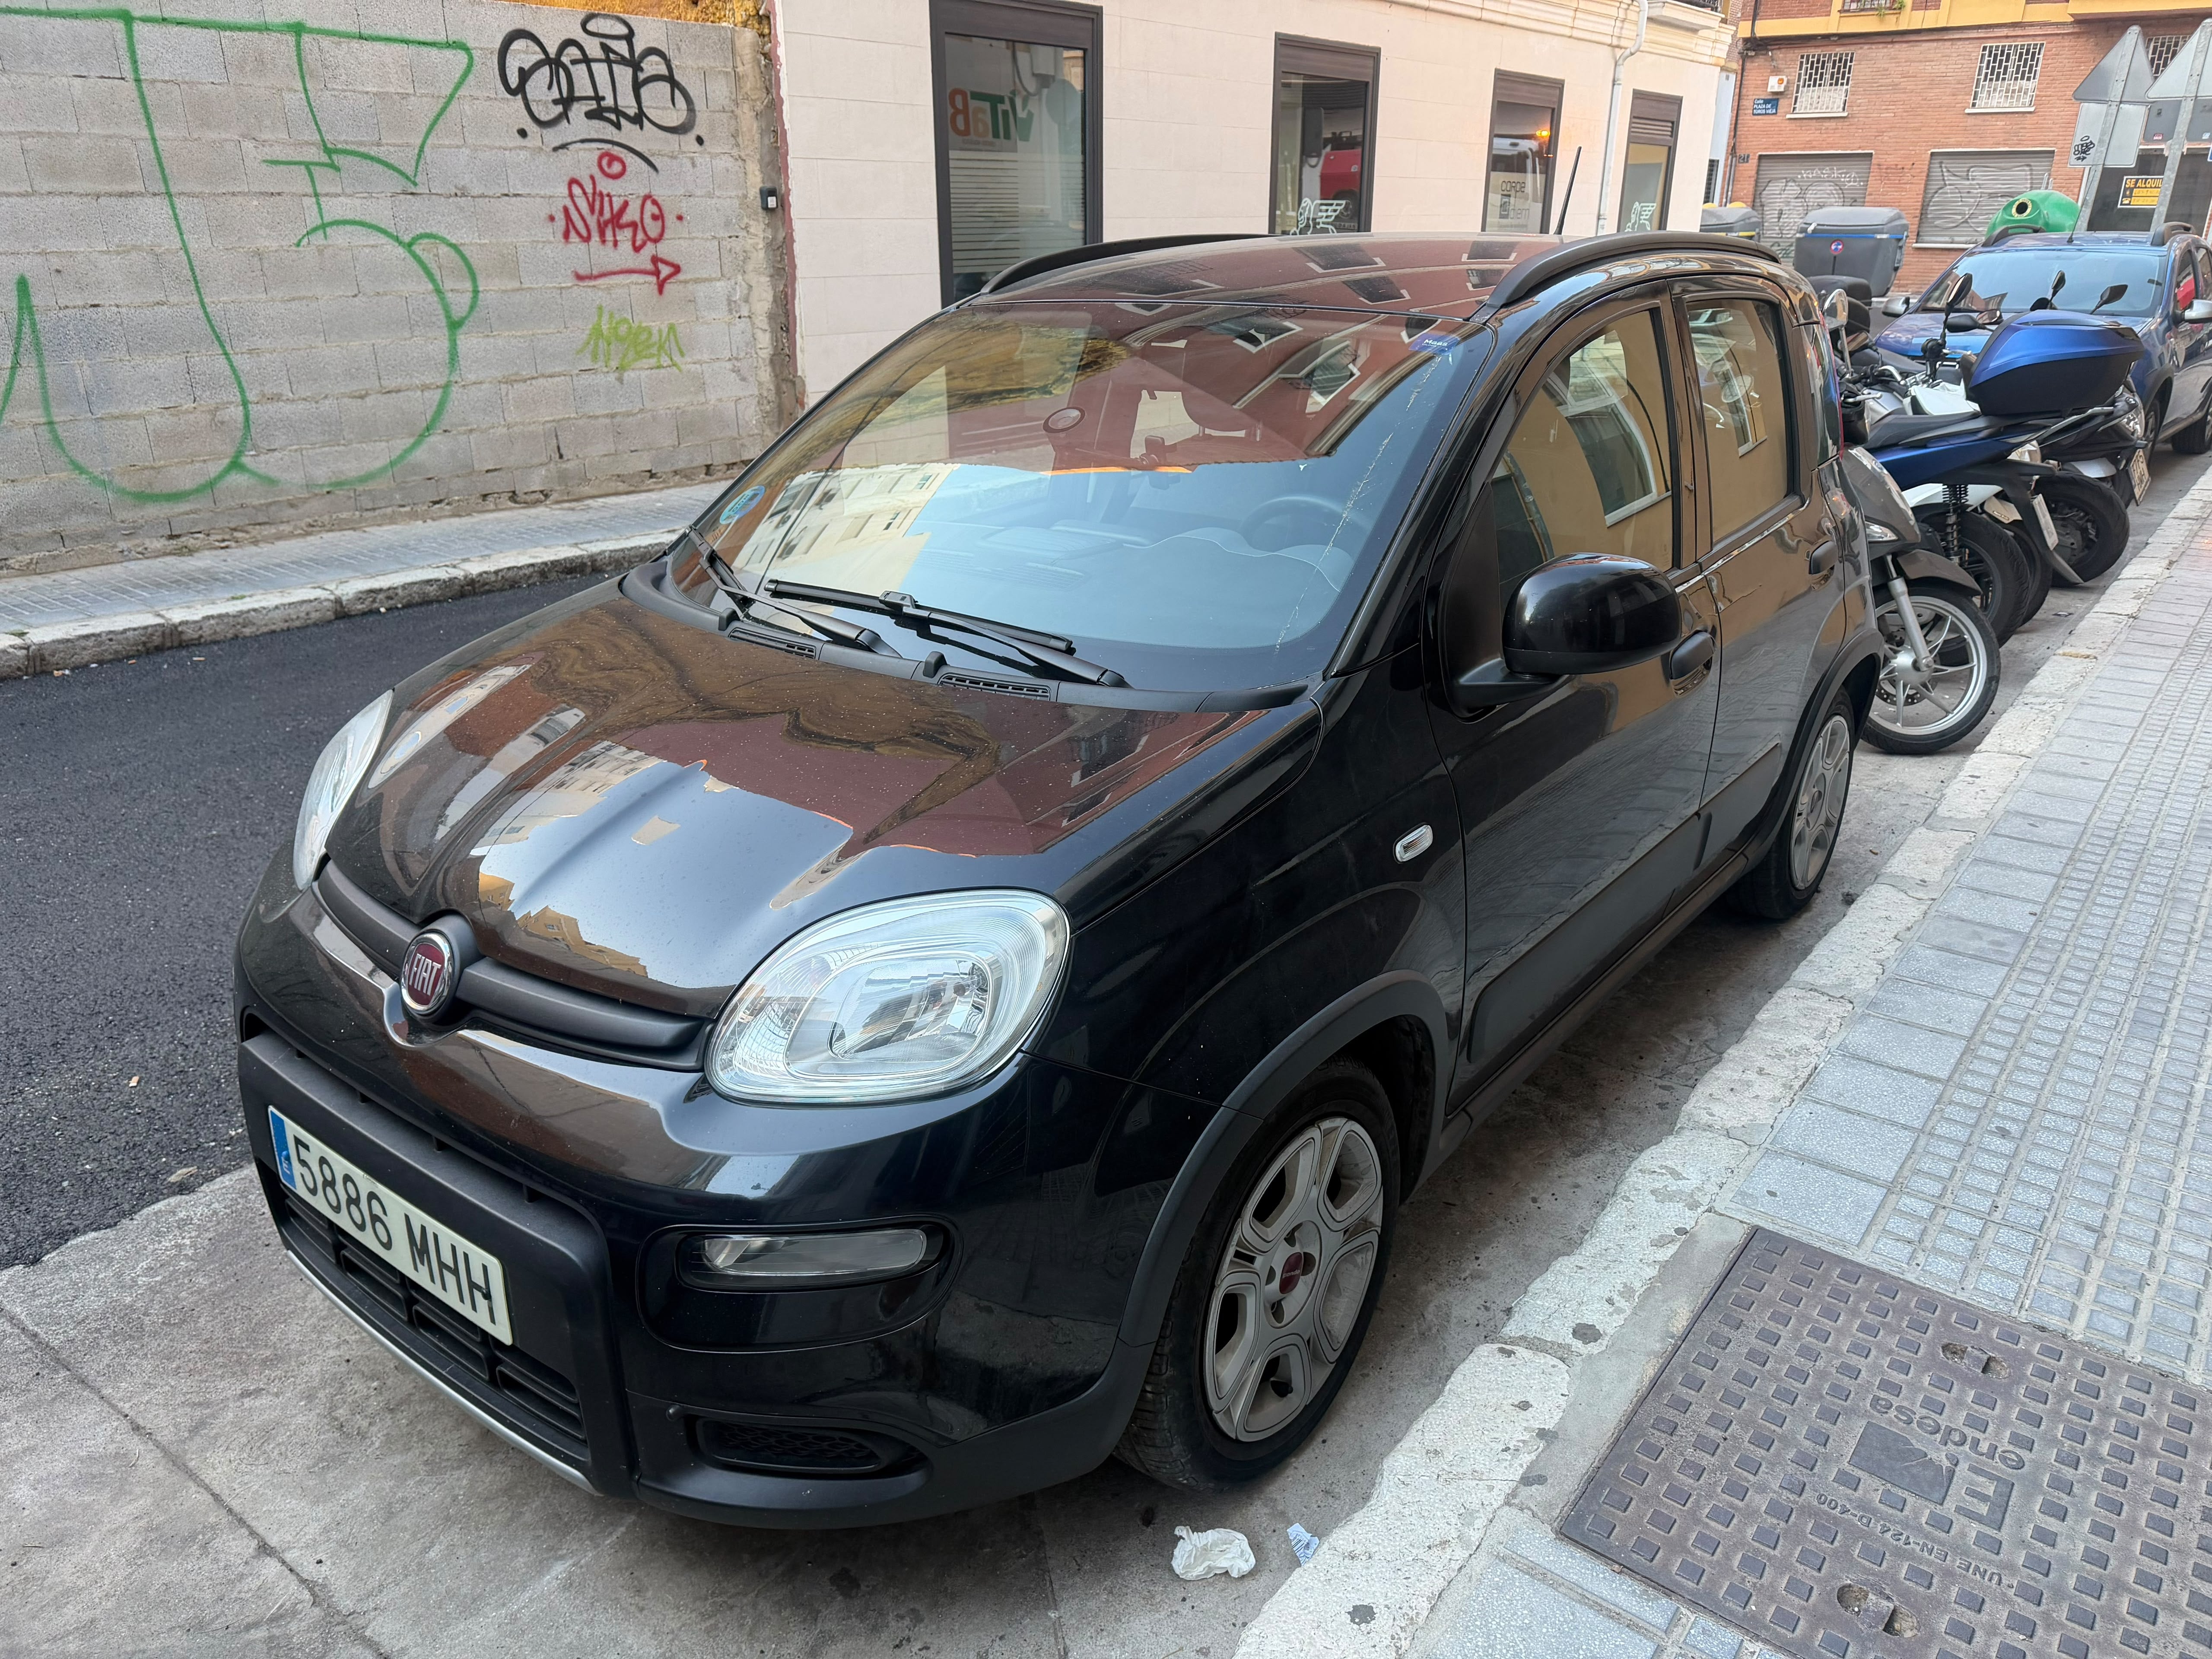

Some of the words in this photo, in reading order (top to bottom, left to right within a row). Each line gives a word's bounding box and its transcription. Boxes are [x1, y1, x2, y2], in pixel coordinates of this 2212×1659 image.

[1739, 154, 1747, 162] 21
[2126, 179, 2136, 188] SE
[2136, 178, 2163, 188] ALQUIL
[409, 953, 442, 996] FIAT
[293, 1135, 392, 1251] 5886
[404, 1213, 496, 1326] MHH
[1869, 1394, 2025, 1470] endesa
[1816, 1493, 1872, 1528] D-400
[1879, 1522, 1948, 1563] EN-124
[1957, 1557, 2003, 1586] UNE
